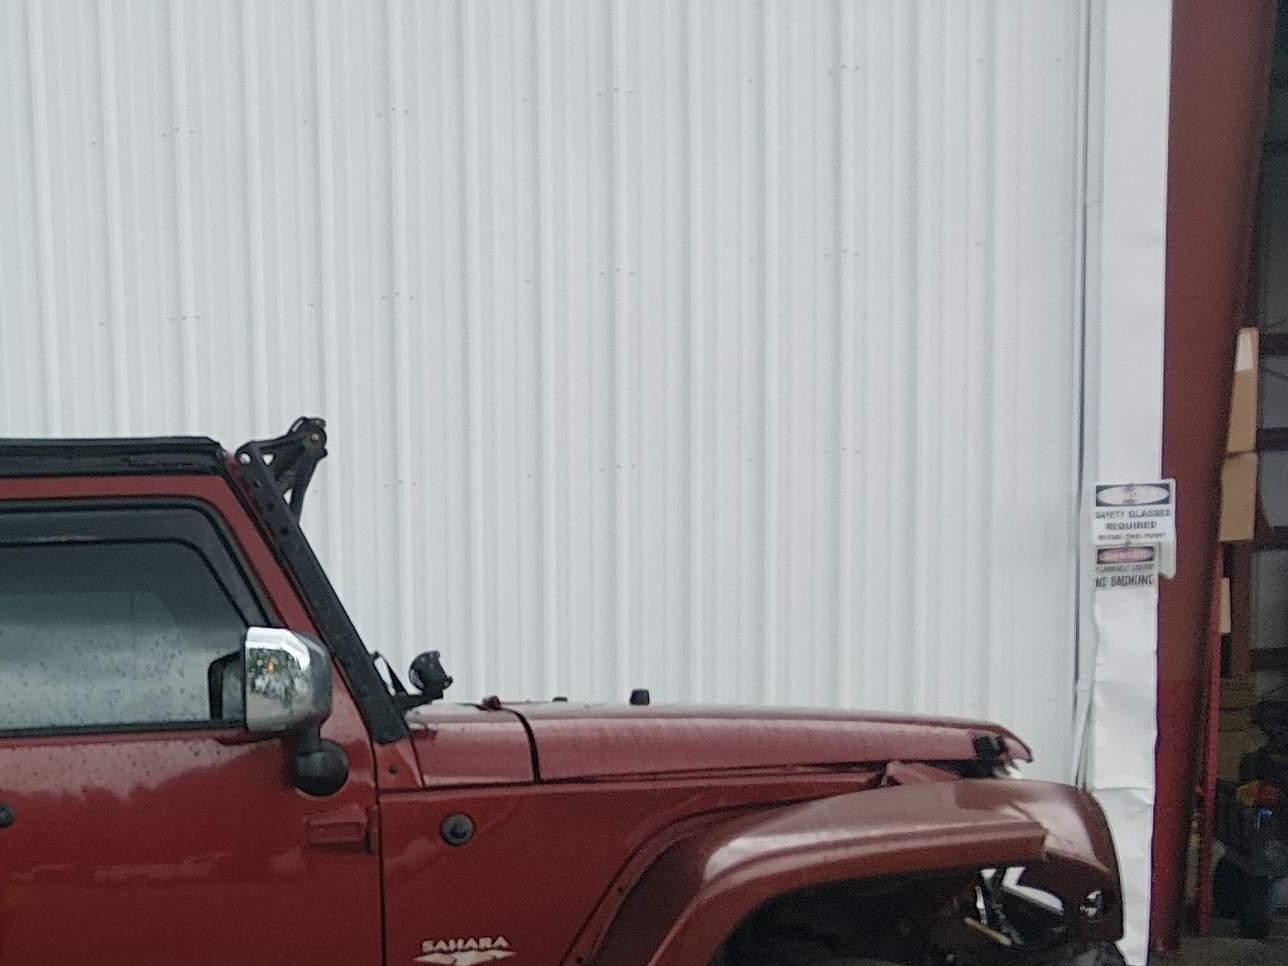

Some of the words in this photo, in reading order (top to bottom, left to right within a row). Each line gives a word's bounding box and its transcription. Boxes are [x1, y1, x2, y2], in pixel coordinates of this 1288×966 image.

[1128, 509, 1172, 518] GLASSES
[1106, 521, 1158, 530] REQUIRED
[1111, 574, 1154, 587] SMOKING
[422, 936, 509, 952] SAHARA
